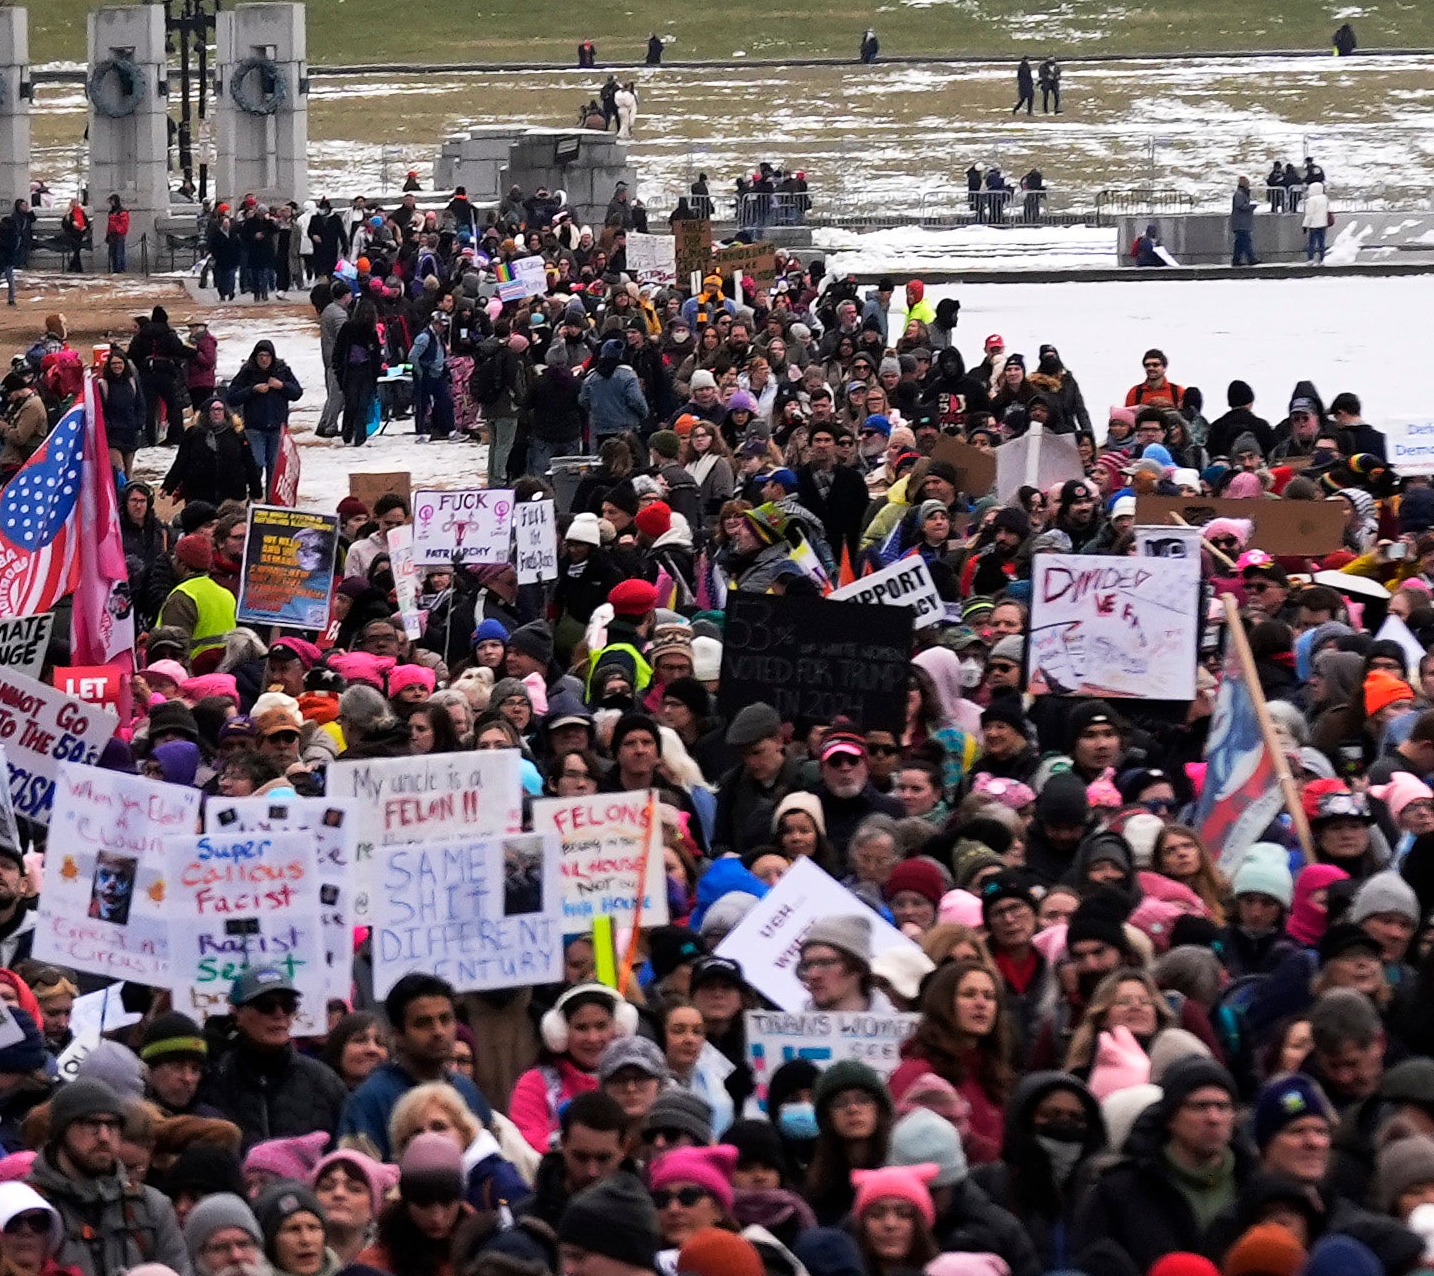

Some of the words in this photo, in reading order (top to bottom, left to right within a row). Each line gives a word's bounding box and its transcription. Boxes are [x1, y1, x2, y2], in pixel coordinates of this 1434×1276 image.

[438, 492, 489, 512] FUCK
[65, 677, 108, 699] LET
[56, 702, 89, 735] GO
[18, 719, 56, 755] THE
[353, 767, 383, 802] My
[390, 765, 437, 793] uncle
[448, 763, 461, 791] is
[468, 769, 484, 790] a
[385, 792, 454, 830] FELON
[553, 803, 653, 835] FELONS
[196, 837, 273, 864] Super
[182, 860, 306, 887] Callous
[384, 841, 489, 893] SAME
[194, 883, 300, 915] Facist
[577, 877, 617, 896] NOT
[388, 883, 491, 925] SHIT
[197, 924, 305, 956] Racist
[380, 916, 557, 963] DIFFERENT
